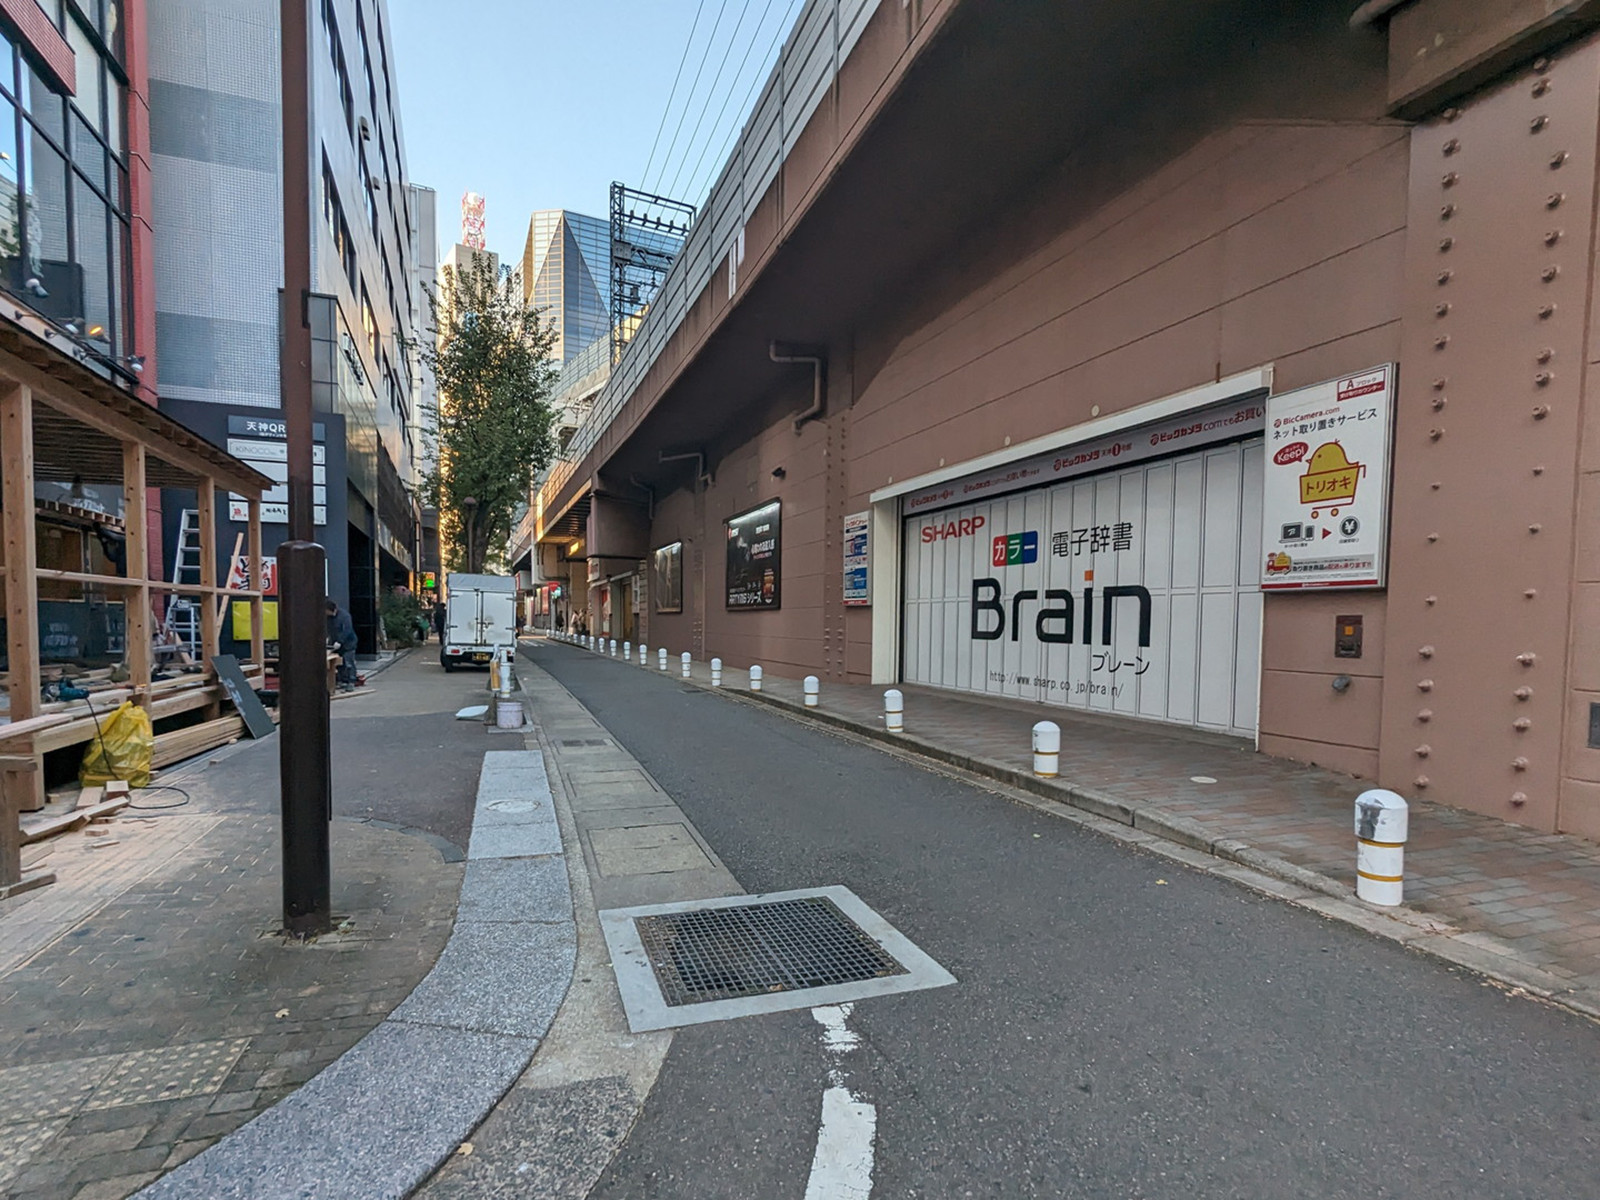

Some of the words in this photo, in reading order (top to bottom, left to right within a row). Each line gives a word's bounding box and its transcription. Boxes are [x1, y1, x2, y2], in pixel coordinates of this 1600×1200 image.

[1347, 379, 1355, 390] A
[1272, 408, 1378, 440] ネット取り置きサービス
[1282, 406, 1341, 426] BicCamera.com
[1276, 446, 1306, 464] Keep!
[1305, 475, 1353, 496] トリオキ
[921, 515, 986, 544] SHARP
[1052, 522, 1133, 557] 電子辞書
[994, 538, 1036, 562] カラー
[971, 570, 1152, 647] Brain
[1091, 650, 1151, 676] ブレーン
